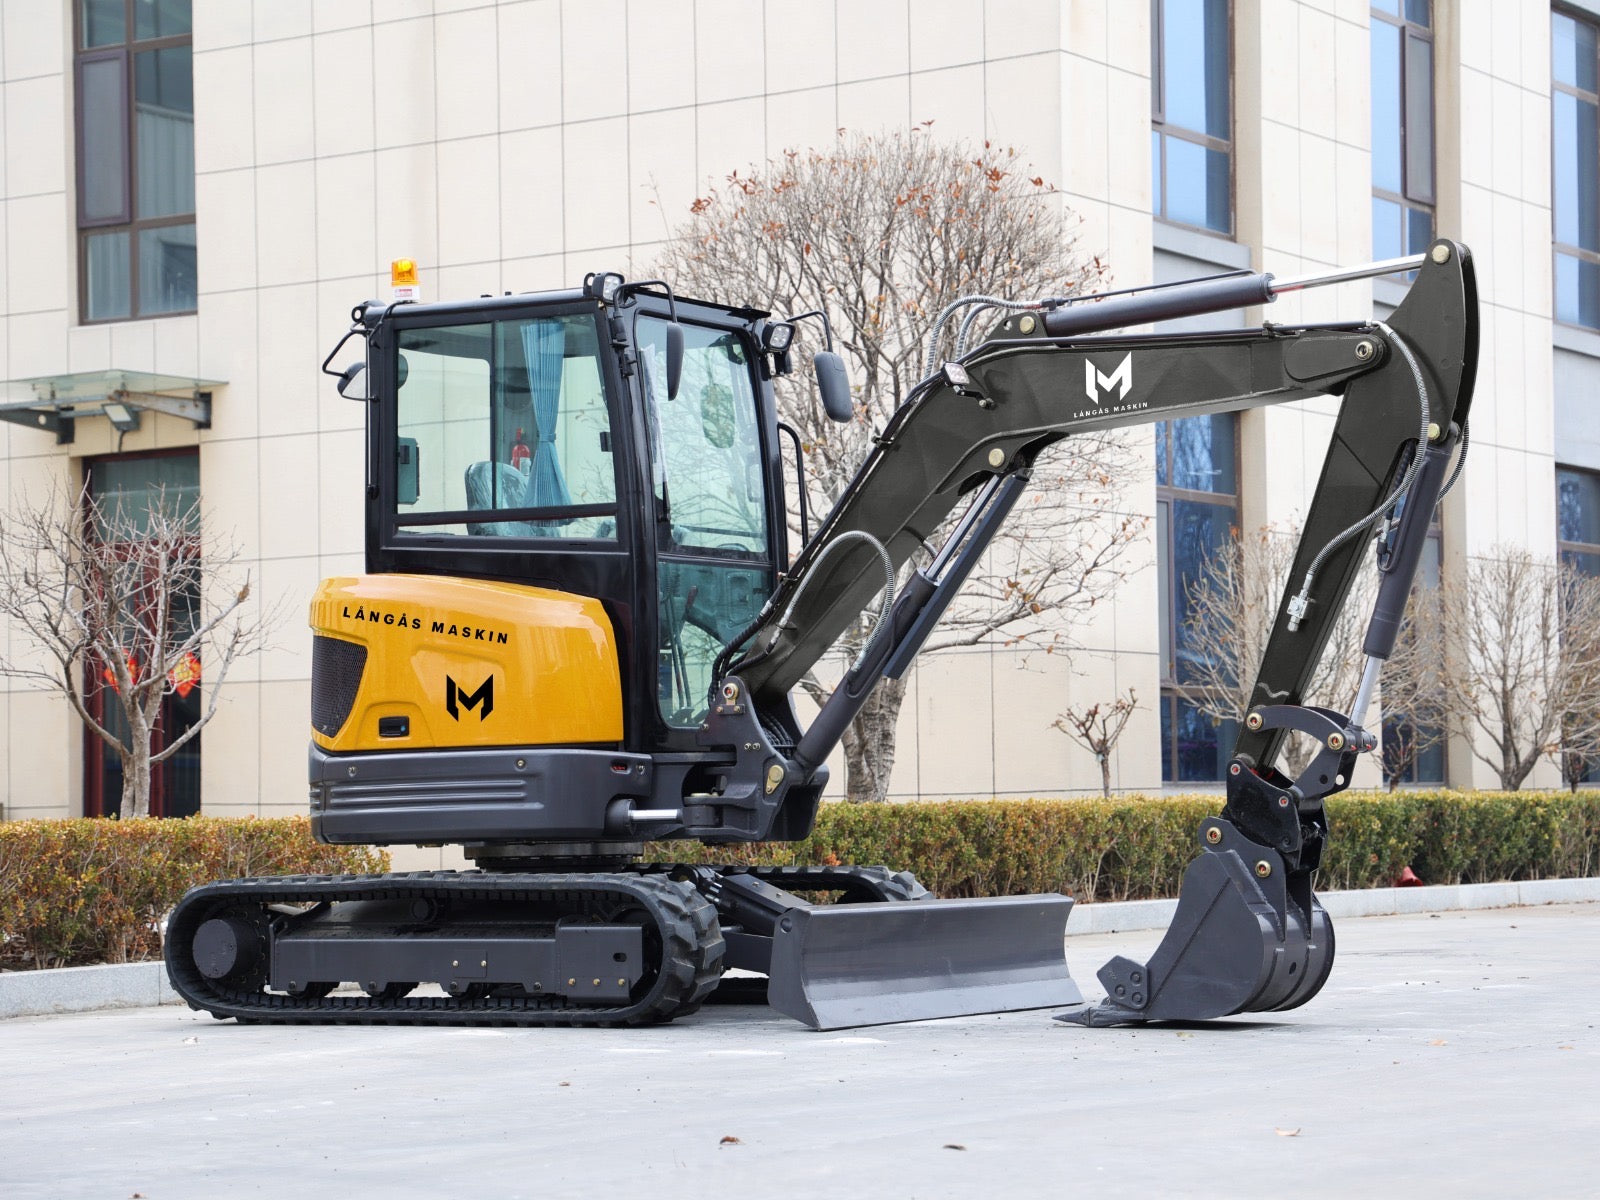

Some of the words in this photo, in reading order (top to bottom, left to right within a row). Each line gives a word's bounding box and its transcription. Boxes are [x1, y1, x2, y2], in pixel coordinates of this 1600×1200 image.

[1073, 407, 1109, 418] LÅNGÅS
[1113, 401, 1148, 412] MASKIN
[343, 606, 421, 629] LÅNGÅS
[431, 621, 508, 644] MASKIN
